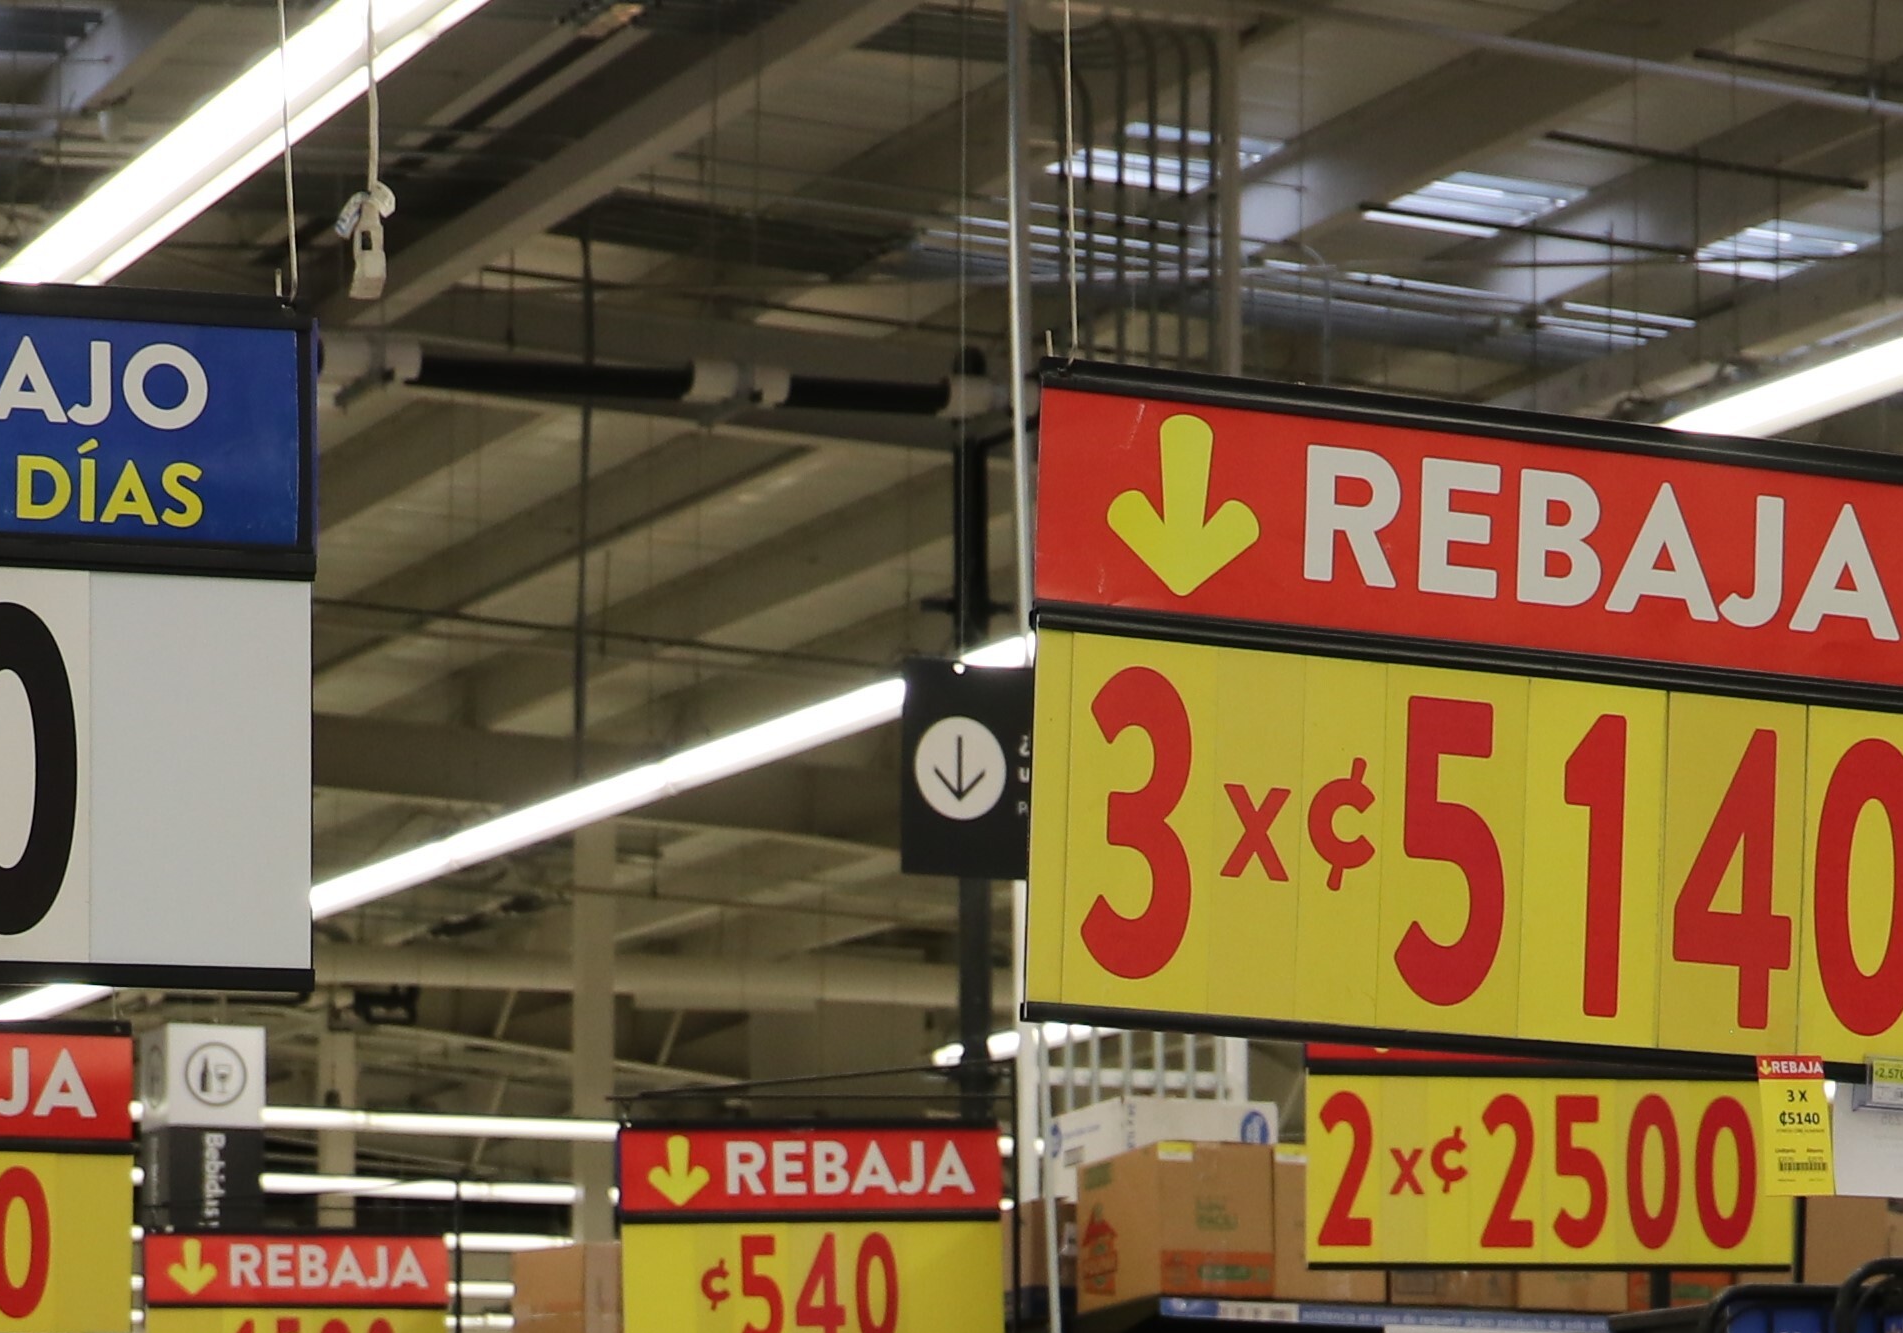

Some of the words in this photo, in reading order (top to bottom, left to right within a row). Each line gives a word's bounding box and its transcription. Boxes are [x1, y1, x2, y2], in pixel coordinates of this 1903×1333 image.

[16, 440, 204, 528] DÍAS
[1304, 444, 1899, 640] REBAJA
[1772, 1061, 1823, 1074] REBAJA
[1788, 1090, 1794, 1102] 3
[1799, 1090, 1808, 1102] X
[725, 1140, 976, 1197] REBAJA
[230, 1242, 429, 1291] REBAJA
